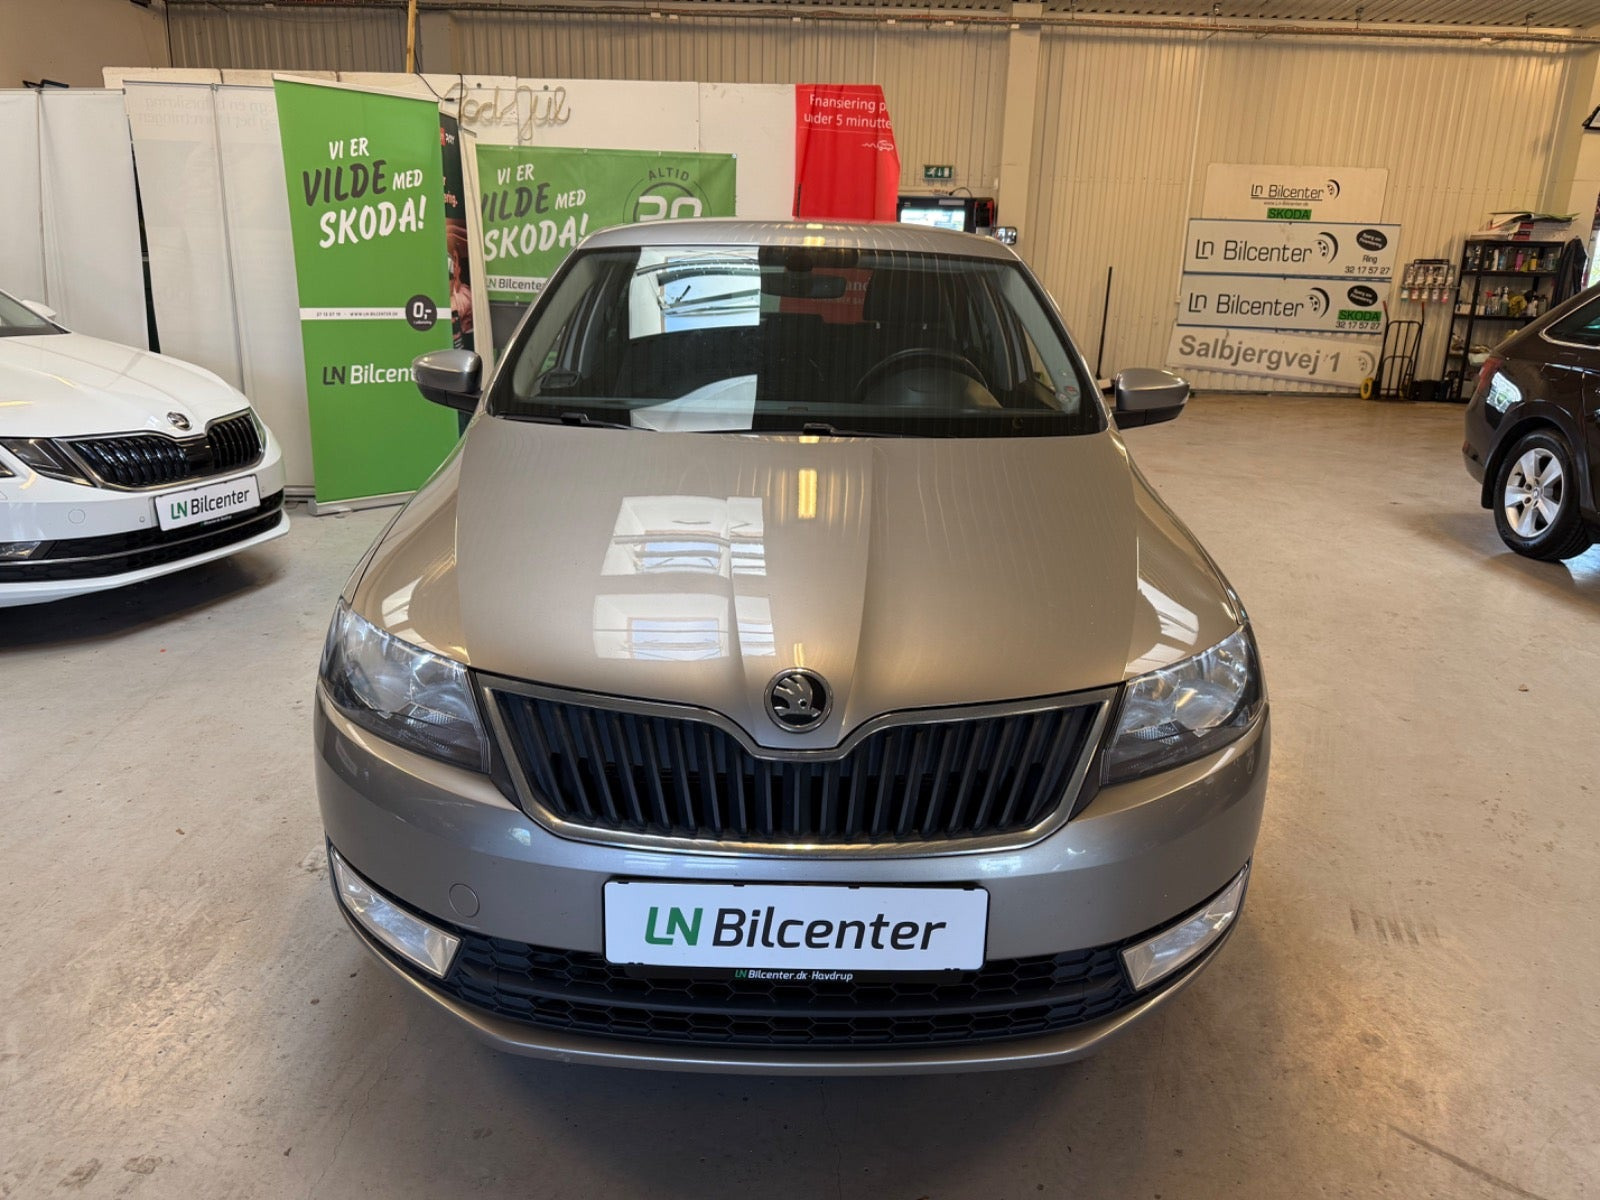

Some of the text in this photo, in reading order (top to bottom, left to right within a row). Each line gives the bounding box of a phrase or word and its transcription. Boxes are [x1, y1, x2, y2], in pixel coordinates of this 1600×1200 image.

[809, 94, 876, 114] Fnansiering
[836, 114, 843, 126] 5
[846, 114, 892, 129] minutte
[329, 137, 370, 160] VI ER
[303, 159, 423, 207] VILDE MED
[497, 163, 535, 185] VI ER
[648, 167, 690, 181] ALTID
[555, 189, 586, 210] MED
[1268, 184, 1324, 199] Bilcenter
[319, 195, 427, 249] SKODA!
[1268, 208, 1311, 219] SKODA
[484, 212, 589, 262] SKODA!
[1195, 239, 1312, 263] Ln Bilcenter
[1362, 254, 1378, 264] Ring
[1344, 266, 1355, 274] 32
[1358, 266, 1367, 274] 17
[1380, 267, 1390, 275] 27
[1188, 293, 1304, 317] Ln Bilcenter
[1339, 310, 1381, 321] SKODA
[1179, 334, 1341, 375] Salbjergvej 1
[323, 363, 416, 385] LN Bilcent
[170, 489, 250, 520] LN Bilcenter
[645, 906, 947, 951] LN Bilcenter
[735, 970, 748, 978] LN
[811, 971, 854, 982] Havdrup
